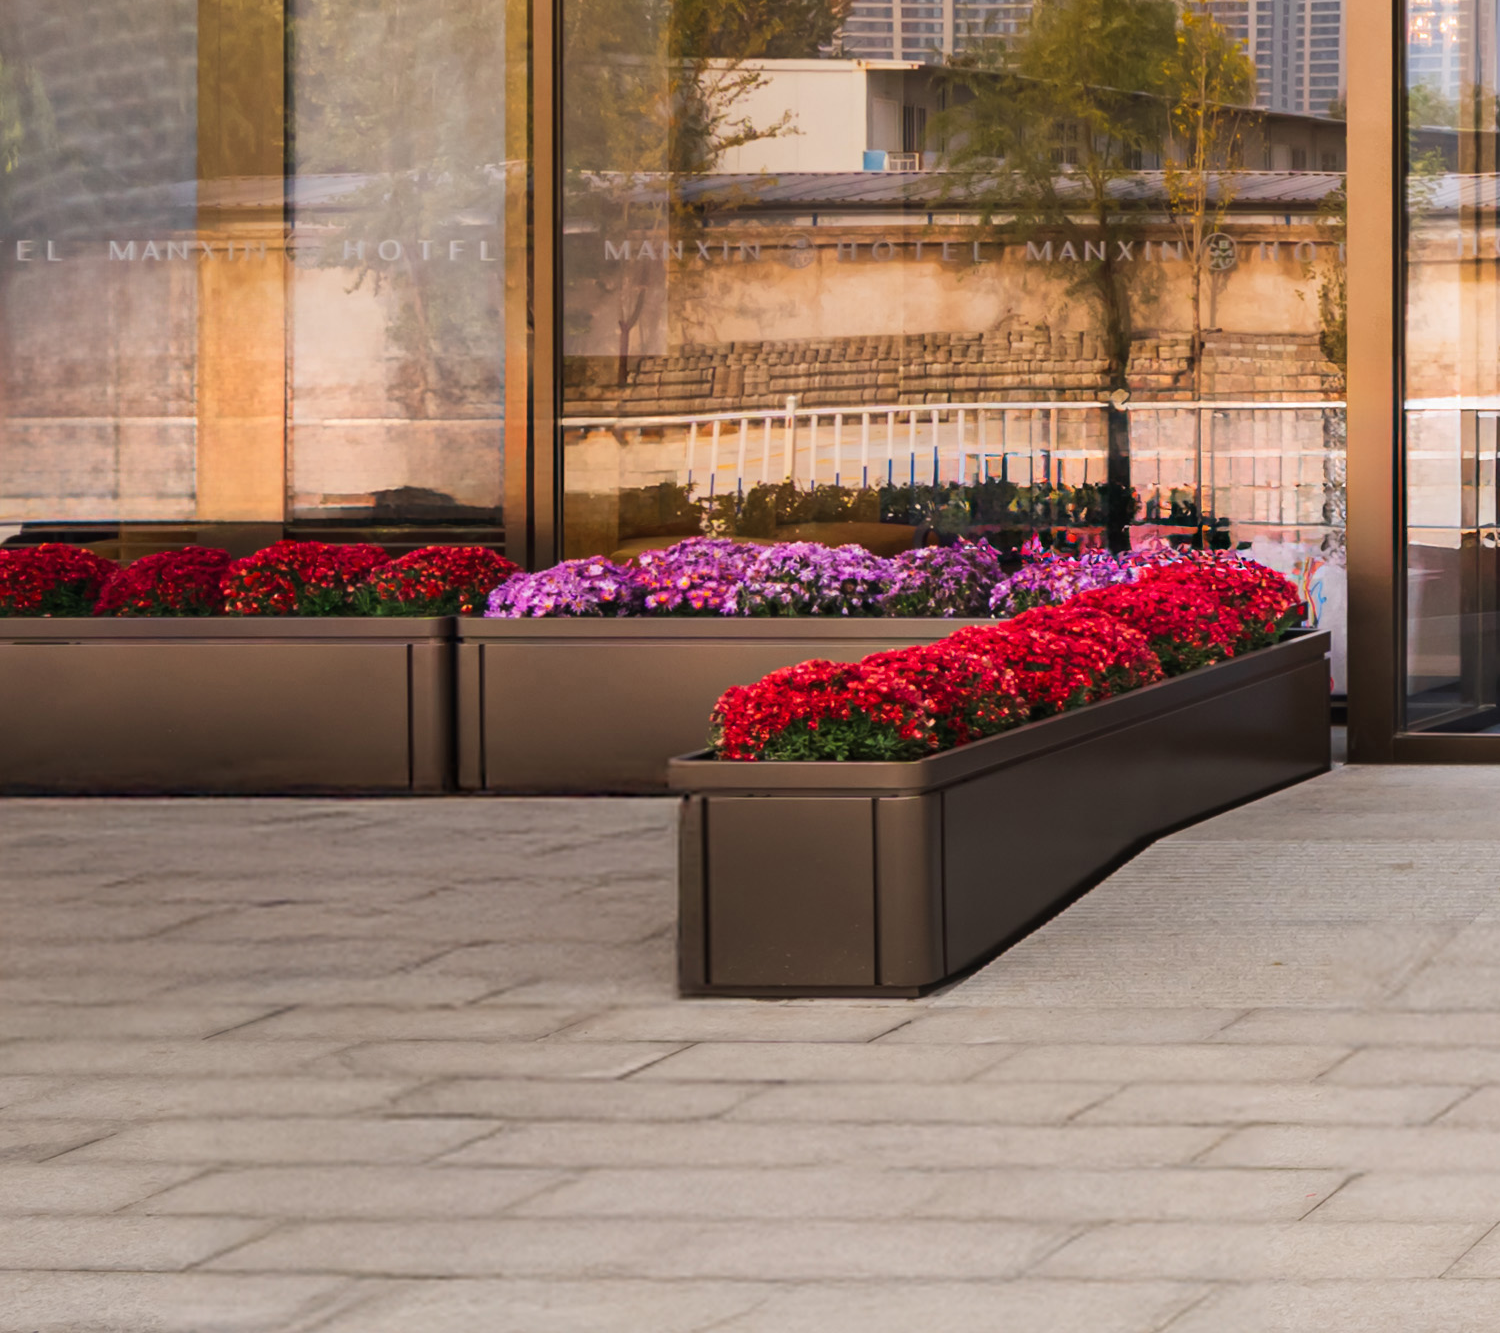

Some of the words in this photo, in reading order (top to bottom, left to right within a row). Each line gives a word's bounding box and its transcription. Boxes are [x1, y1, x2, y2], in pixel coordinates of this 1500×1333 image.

[0, 239, 64, 262] EL
[603, 239, 762, 261] MANXIN
[837, 239, 990, 262] HOTEL
[1025, 240, 1186, 262] MANXIN
